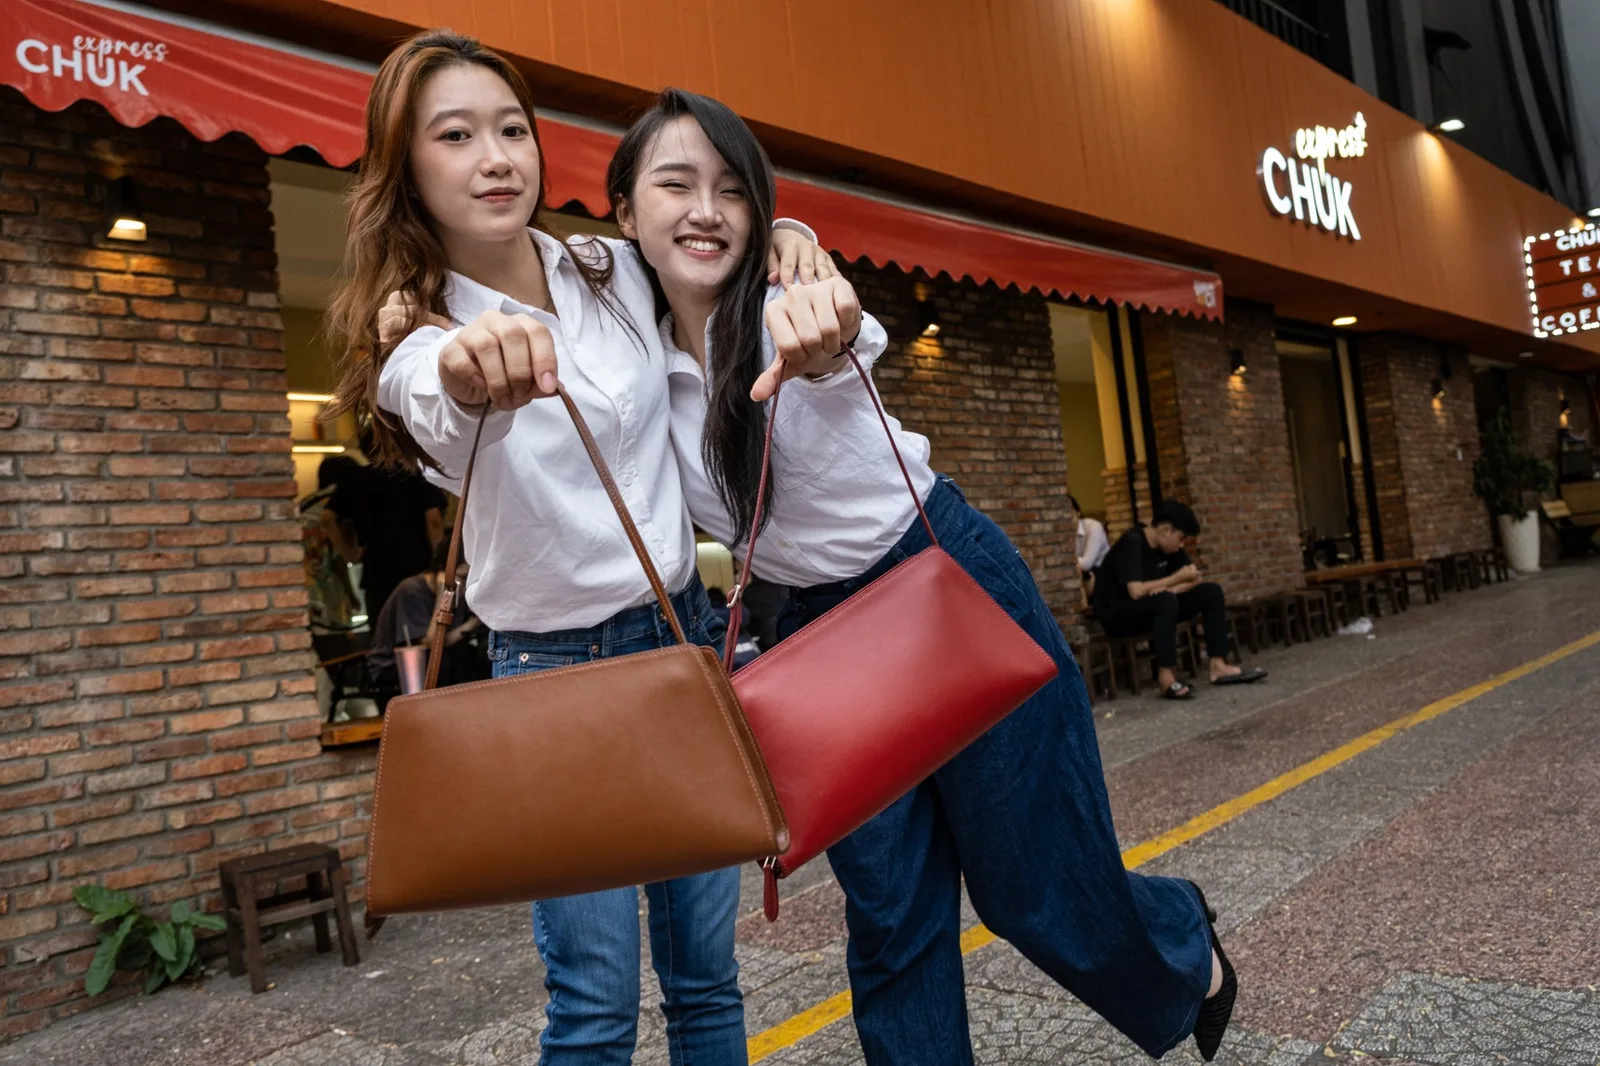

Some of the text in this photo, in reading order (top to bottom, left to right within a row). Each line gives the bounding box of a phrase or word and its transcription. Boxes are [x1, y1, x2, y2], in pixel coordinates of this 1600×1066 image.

[15, 38, 150, 96] CHUK
[72, 35, 169, 68] express
[1262, 147, 1362, 241] CHUK
[1582, 282, 1597, 298] &
